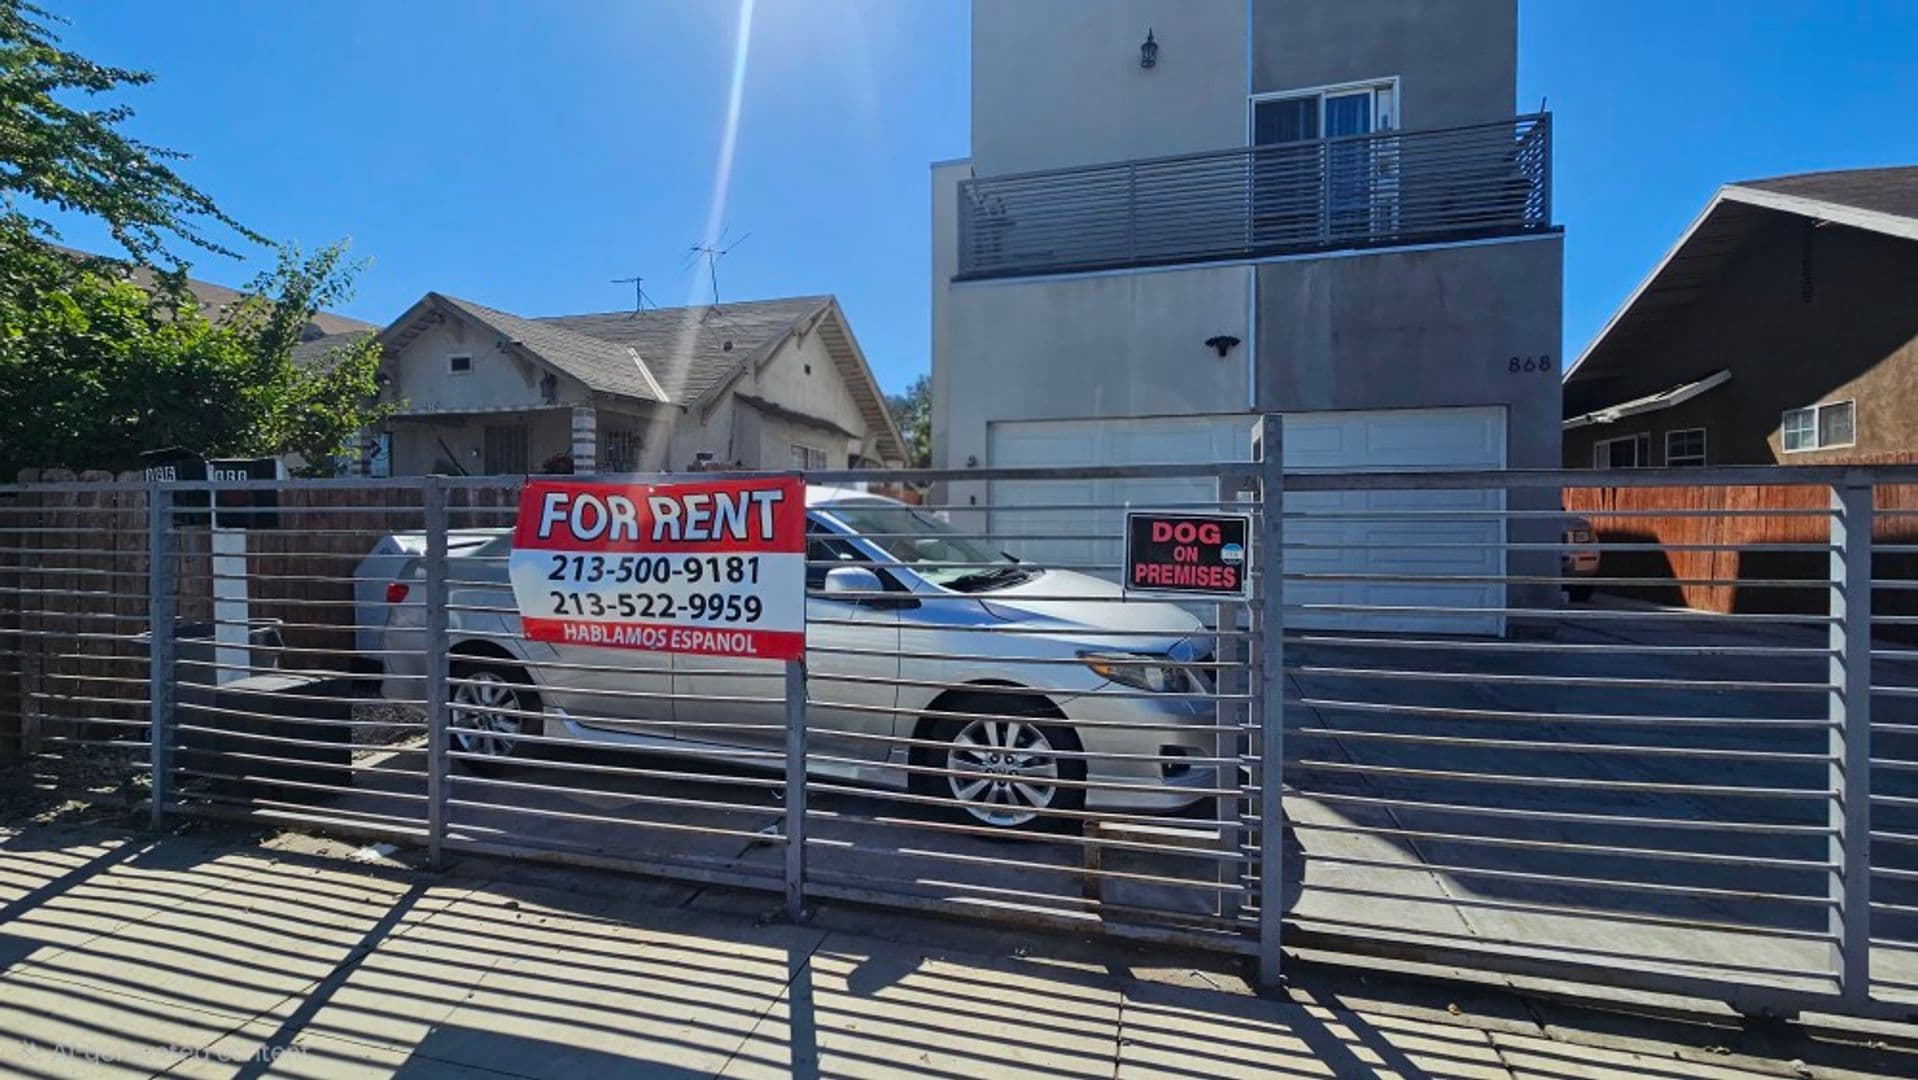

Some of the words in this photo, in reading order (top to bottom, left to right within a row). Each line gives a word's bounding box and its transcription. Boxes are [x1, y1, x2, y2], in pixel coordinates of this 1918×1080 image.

[1508, 354, 1551, 373] 868
[537, 489, 639, 542] FOR
[648, 488, 785, 543] RENT
[1151, 521, 1222, 545] DOG
[1173, 545, 1199, 562] ON
[548, 554, 761, 584] 213-500-9181
[1135, 563, 1236, 588] PREMISES
[550, 590, 763, 623] 213-522-9959
[563, 623, 667, 649] HABLAMOS
[671, 629, 757, 654] ESPANOL
